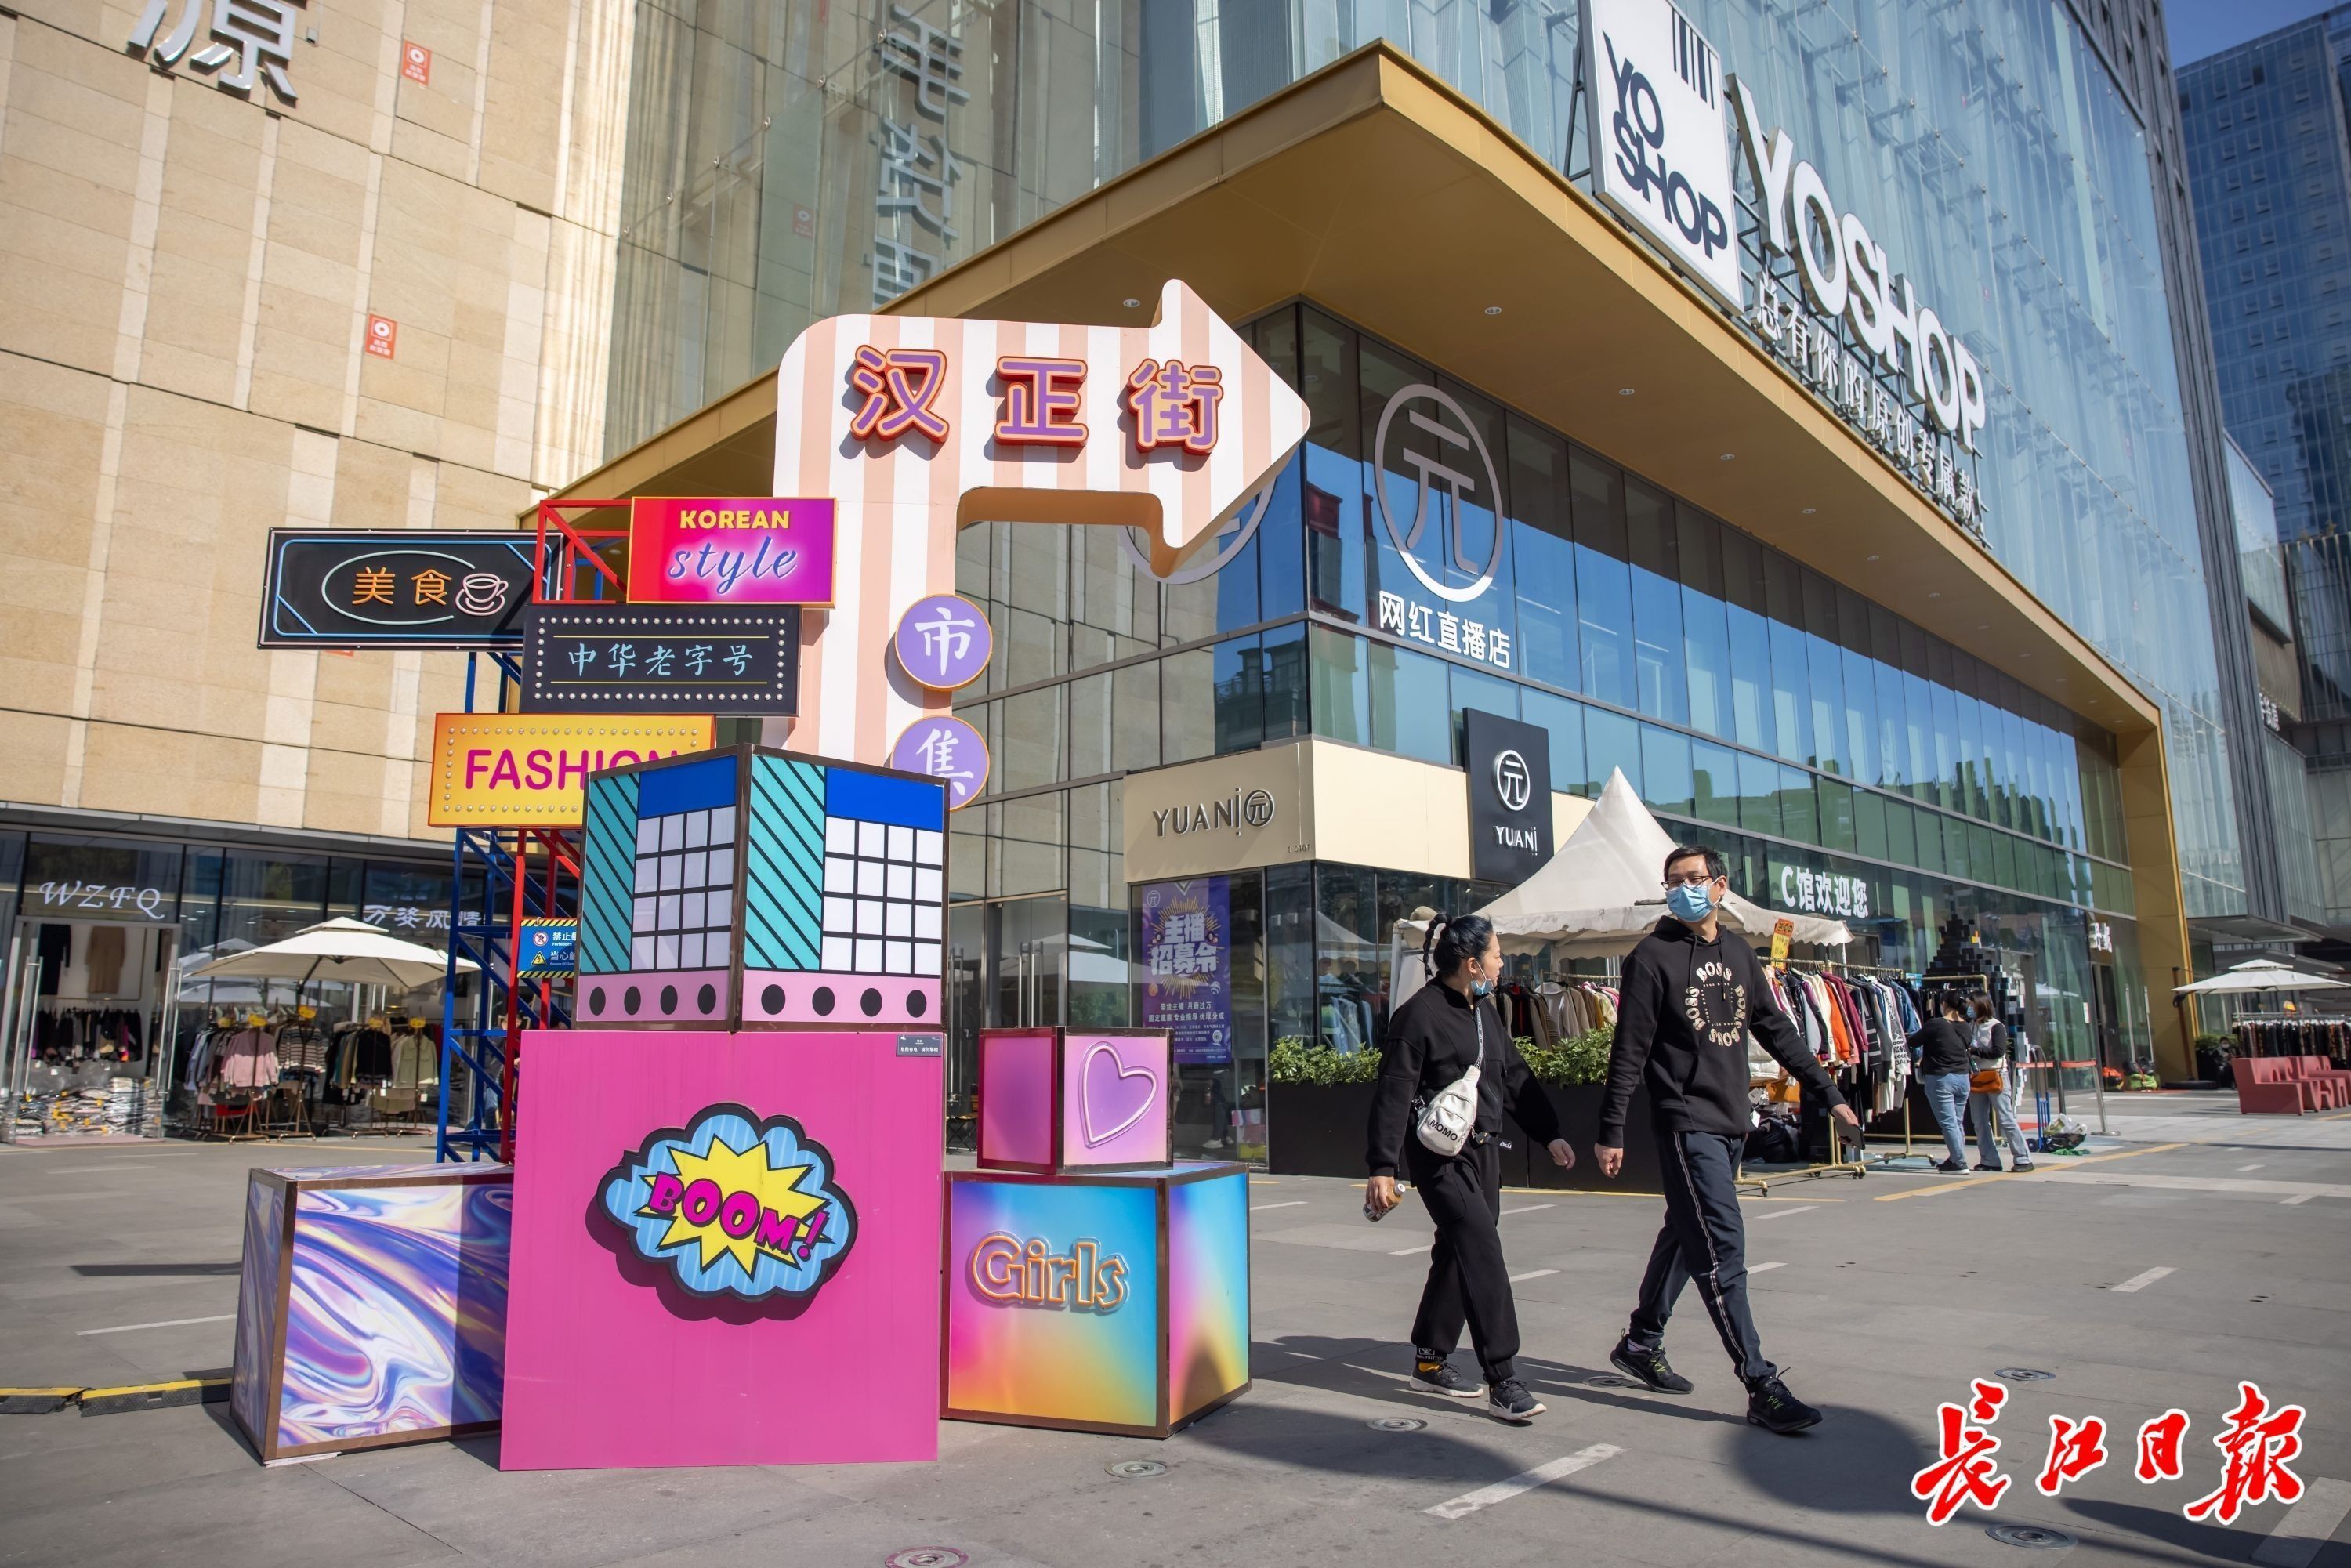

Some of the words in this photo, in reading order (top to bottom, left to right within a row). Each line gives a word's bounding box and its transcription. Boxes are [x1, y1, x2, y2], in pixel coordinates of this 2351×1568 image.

[1601, 28, 1665, 151] YO
[1612, 110, 1729, 262] SHOP
[1726, 72, 1987, 454] YOSHOP
[850, 343, 1225, 456] 汉正街
[679, 509, 790, 530] KOREAN
[352, 566, 452, 606] 美食
[668, 535, 798, 595] style
[915, 607, 972, 675] 市
[1378, 590, 1511, 669] 网红直播店
[568, 642, 754, 677] 中华老字号
[915, 728, 973, 796] 集
[39, 880, 165, 919] WZFQ
[1781, 865, 1869, 918] C馆欢迎您
[363, 904, 483, 930] 万姿风情
[1164, 913, 1205, 944] 主播
[1150, 943, 1217, 976] 招募令
[1696, 961, 1733, 983] BOSS
[1686, 986, 1708, 1031] BOSS
[1708, 1027, 1740, 1048] BOSS
[1429, 1120, 1458, 1141] MOMO
[647, 1171, 831, 1262] BOOM!
[971, 1233, 1125, 1309] Girls
